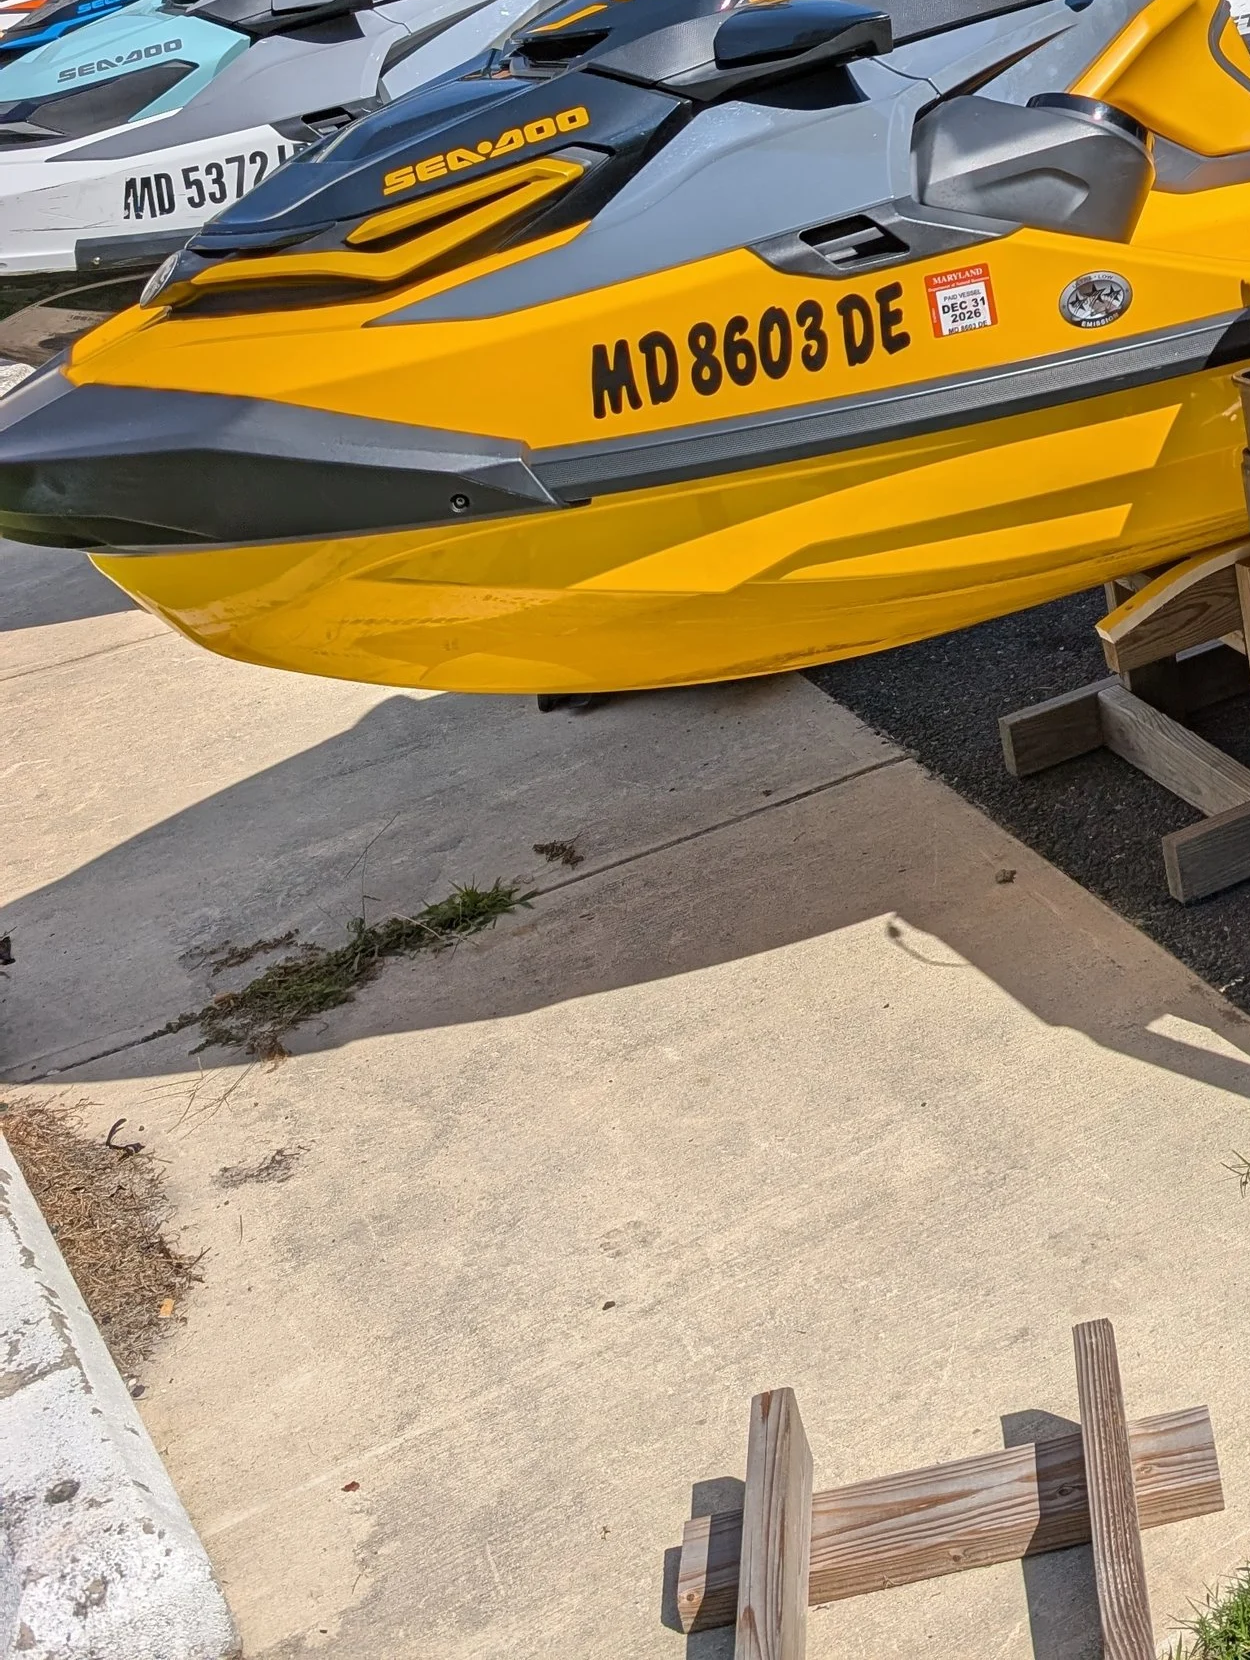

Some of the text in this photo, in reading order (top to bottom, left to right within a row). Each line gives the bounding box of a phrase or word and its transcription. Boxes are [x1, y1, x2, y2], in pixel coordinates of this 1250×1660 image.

[123, 172, 176, 220] MD
[181, 150, 269, 209] 5372
[932, 267, 983, 285] MARYLAND
[943, 289, 981, 302] PAID VESSEL
[942, 296, 986, 314] DEC 31
[950, 308, 982, 323] 2026
[591, 281, 911, 419] MD 8603 DE
